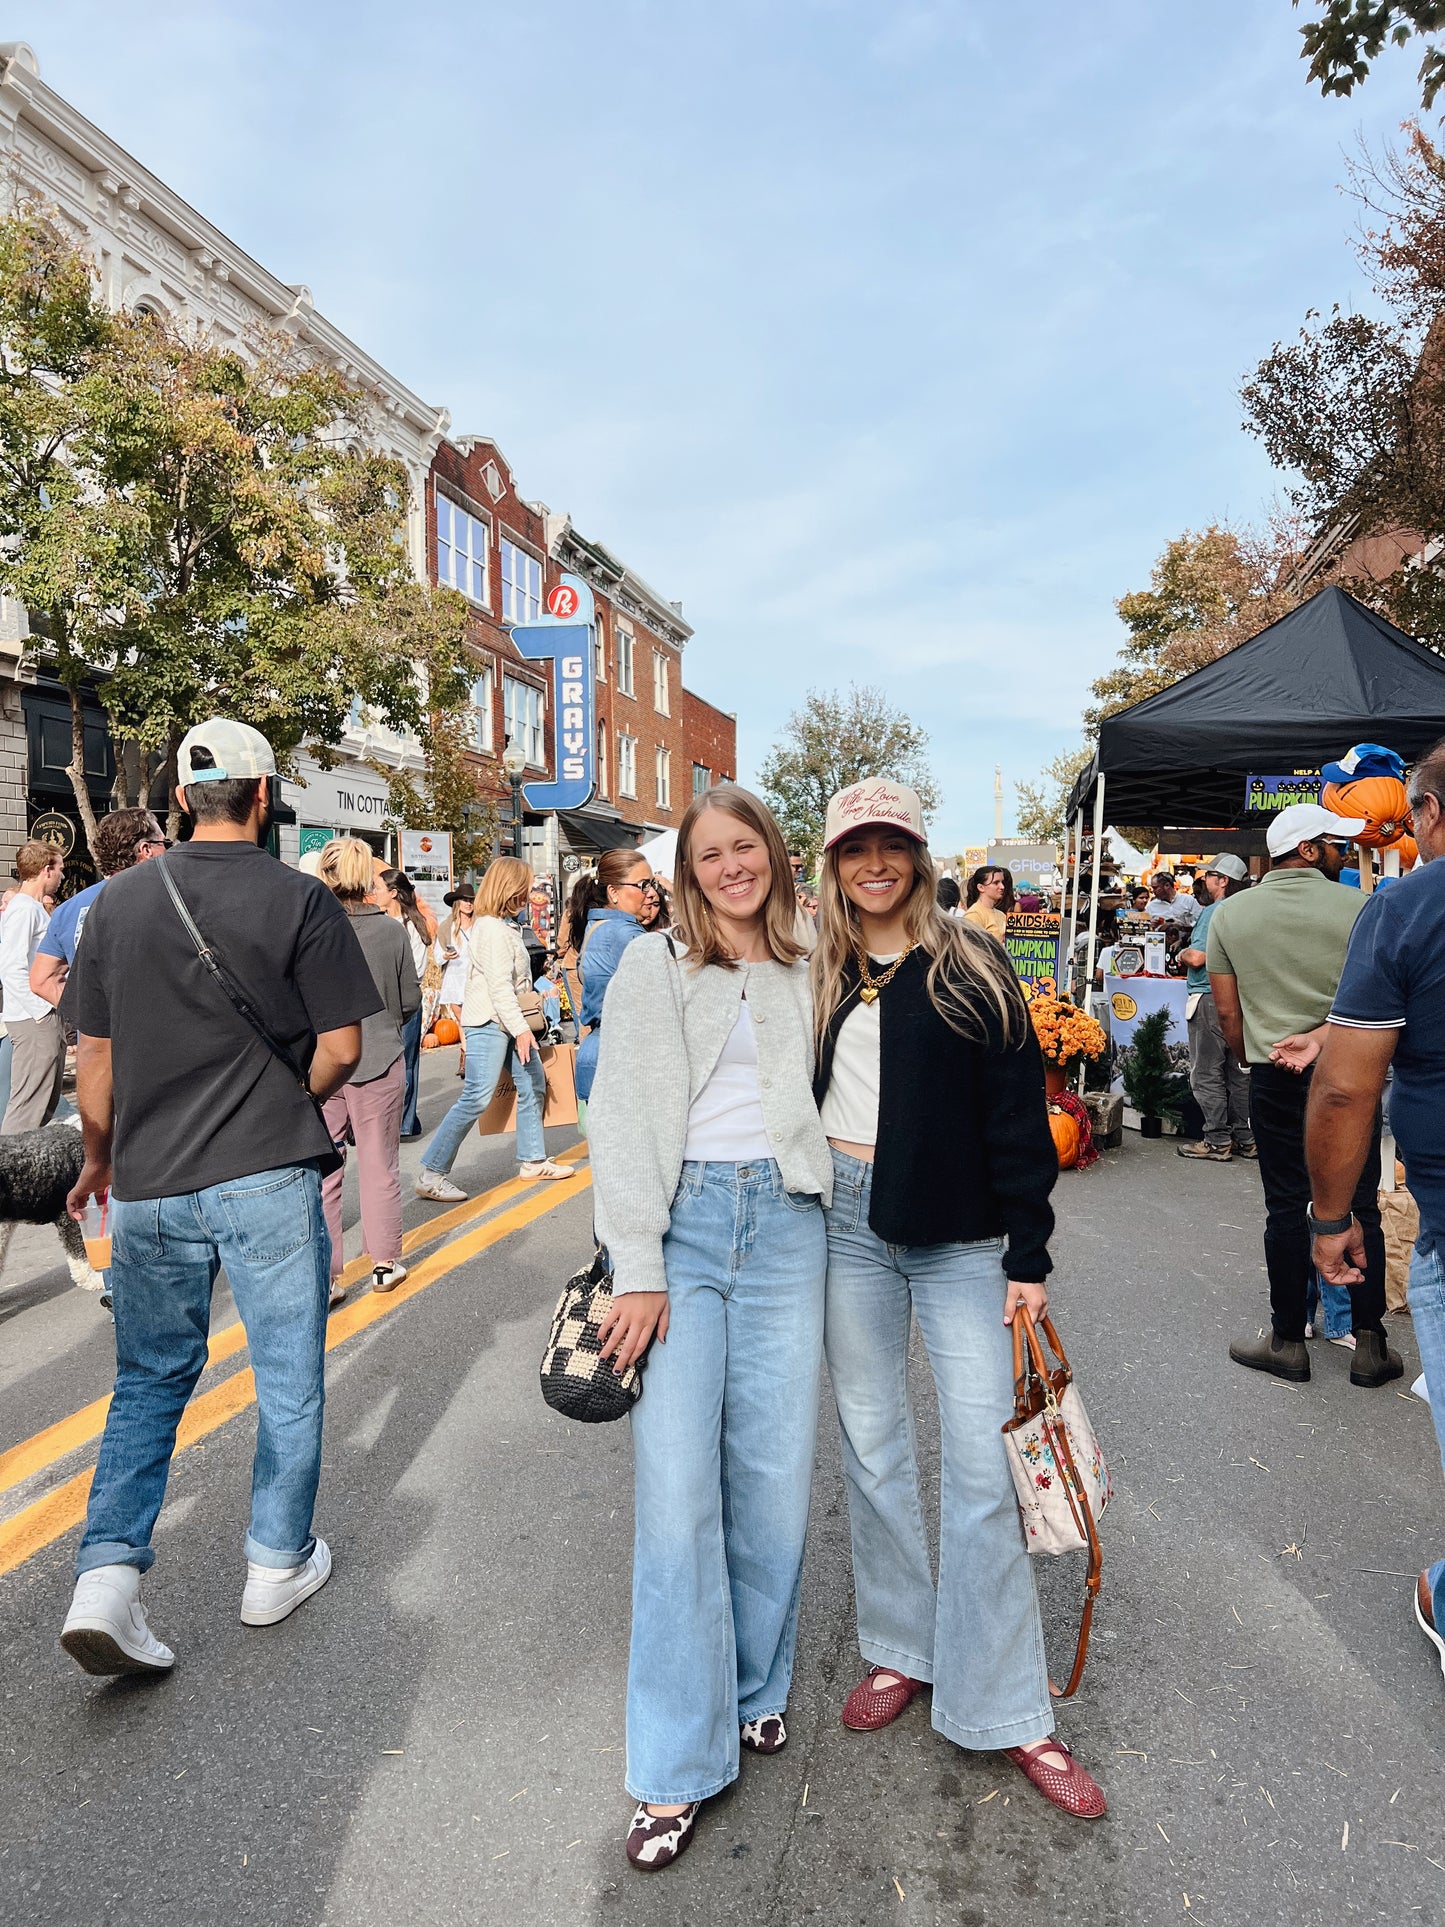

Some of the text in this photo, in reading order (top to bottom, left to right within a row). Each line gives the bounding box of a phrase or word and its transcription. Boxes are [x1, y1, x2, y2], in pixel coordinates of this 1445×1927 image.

[561, 655, 588, 781] GRAY'S
[337, 790, 403, 818] TIN COTTA
[837, 787, 866, 811] With
[1248, 792, 1318, 811] PUMPKIN
[1008, 858, 1054, 873] GFiber
[1016, 914, 1047, 928] KIDS!
[1005, 939, 1056, 959] PUMPKIN
[1012, 959, 1055, 978] INTING
[1031, 976, 1057, 1001] $3
